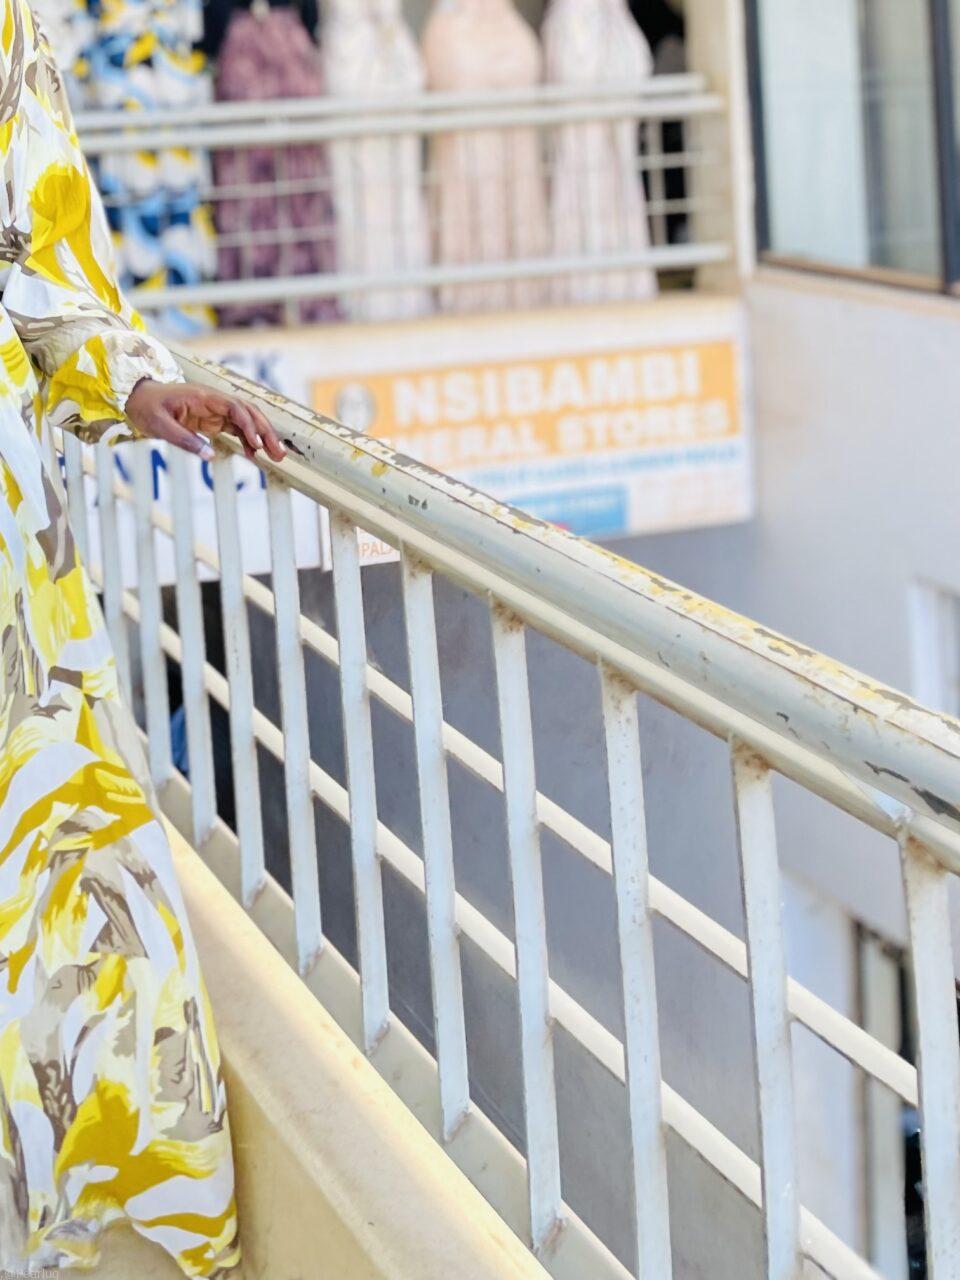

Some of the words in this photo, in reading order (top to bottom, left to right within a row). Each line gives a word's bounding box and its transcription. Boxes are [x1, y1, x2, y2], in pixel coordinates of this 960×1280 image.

[393, 351, 700, 427] NSIBAMBI
[382, 420, 545, 466] NERAL
[557, 399, 728, 454] STORES
